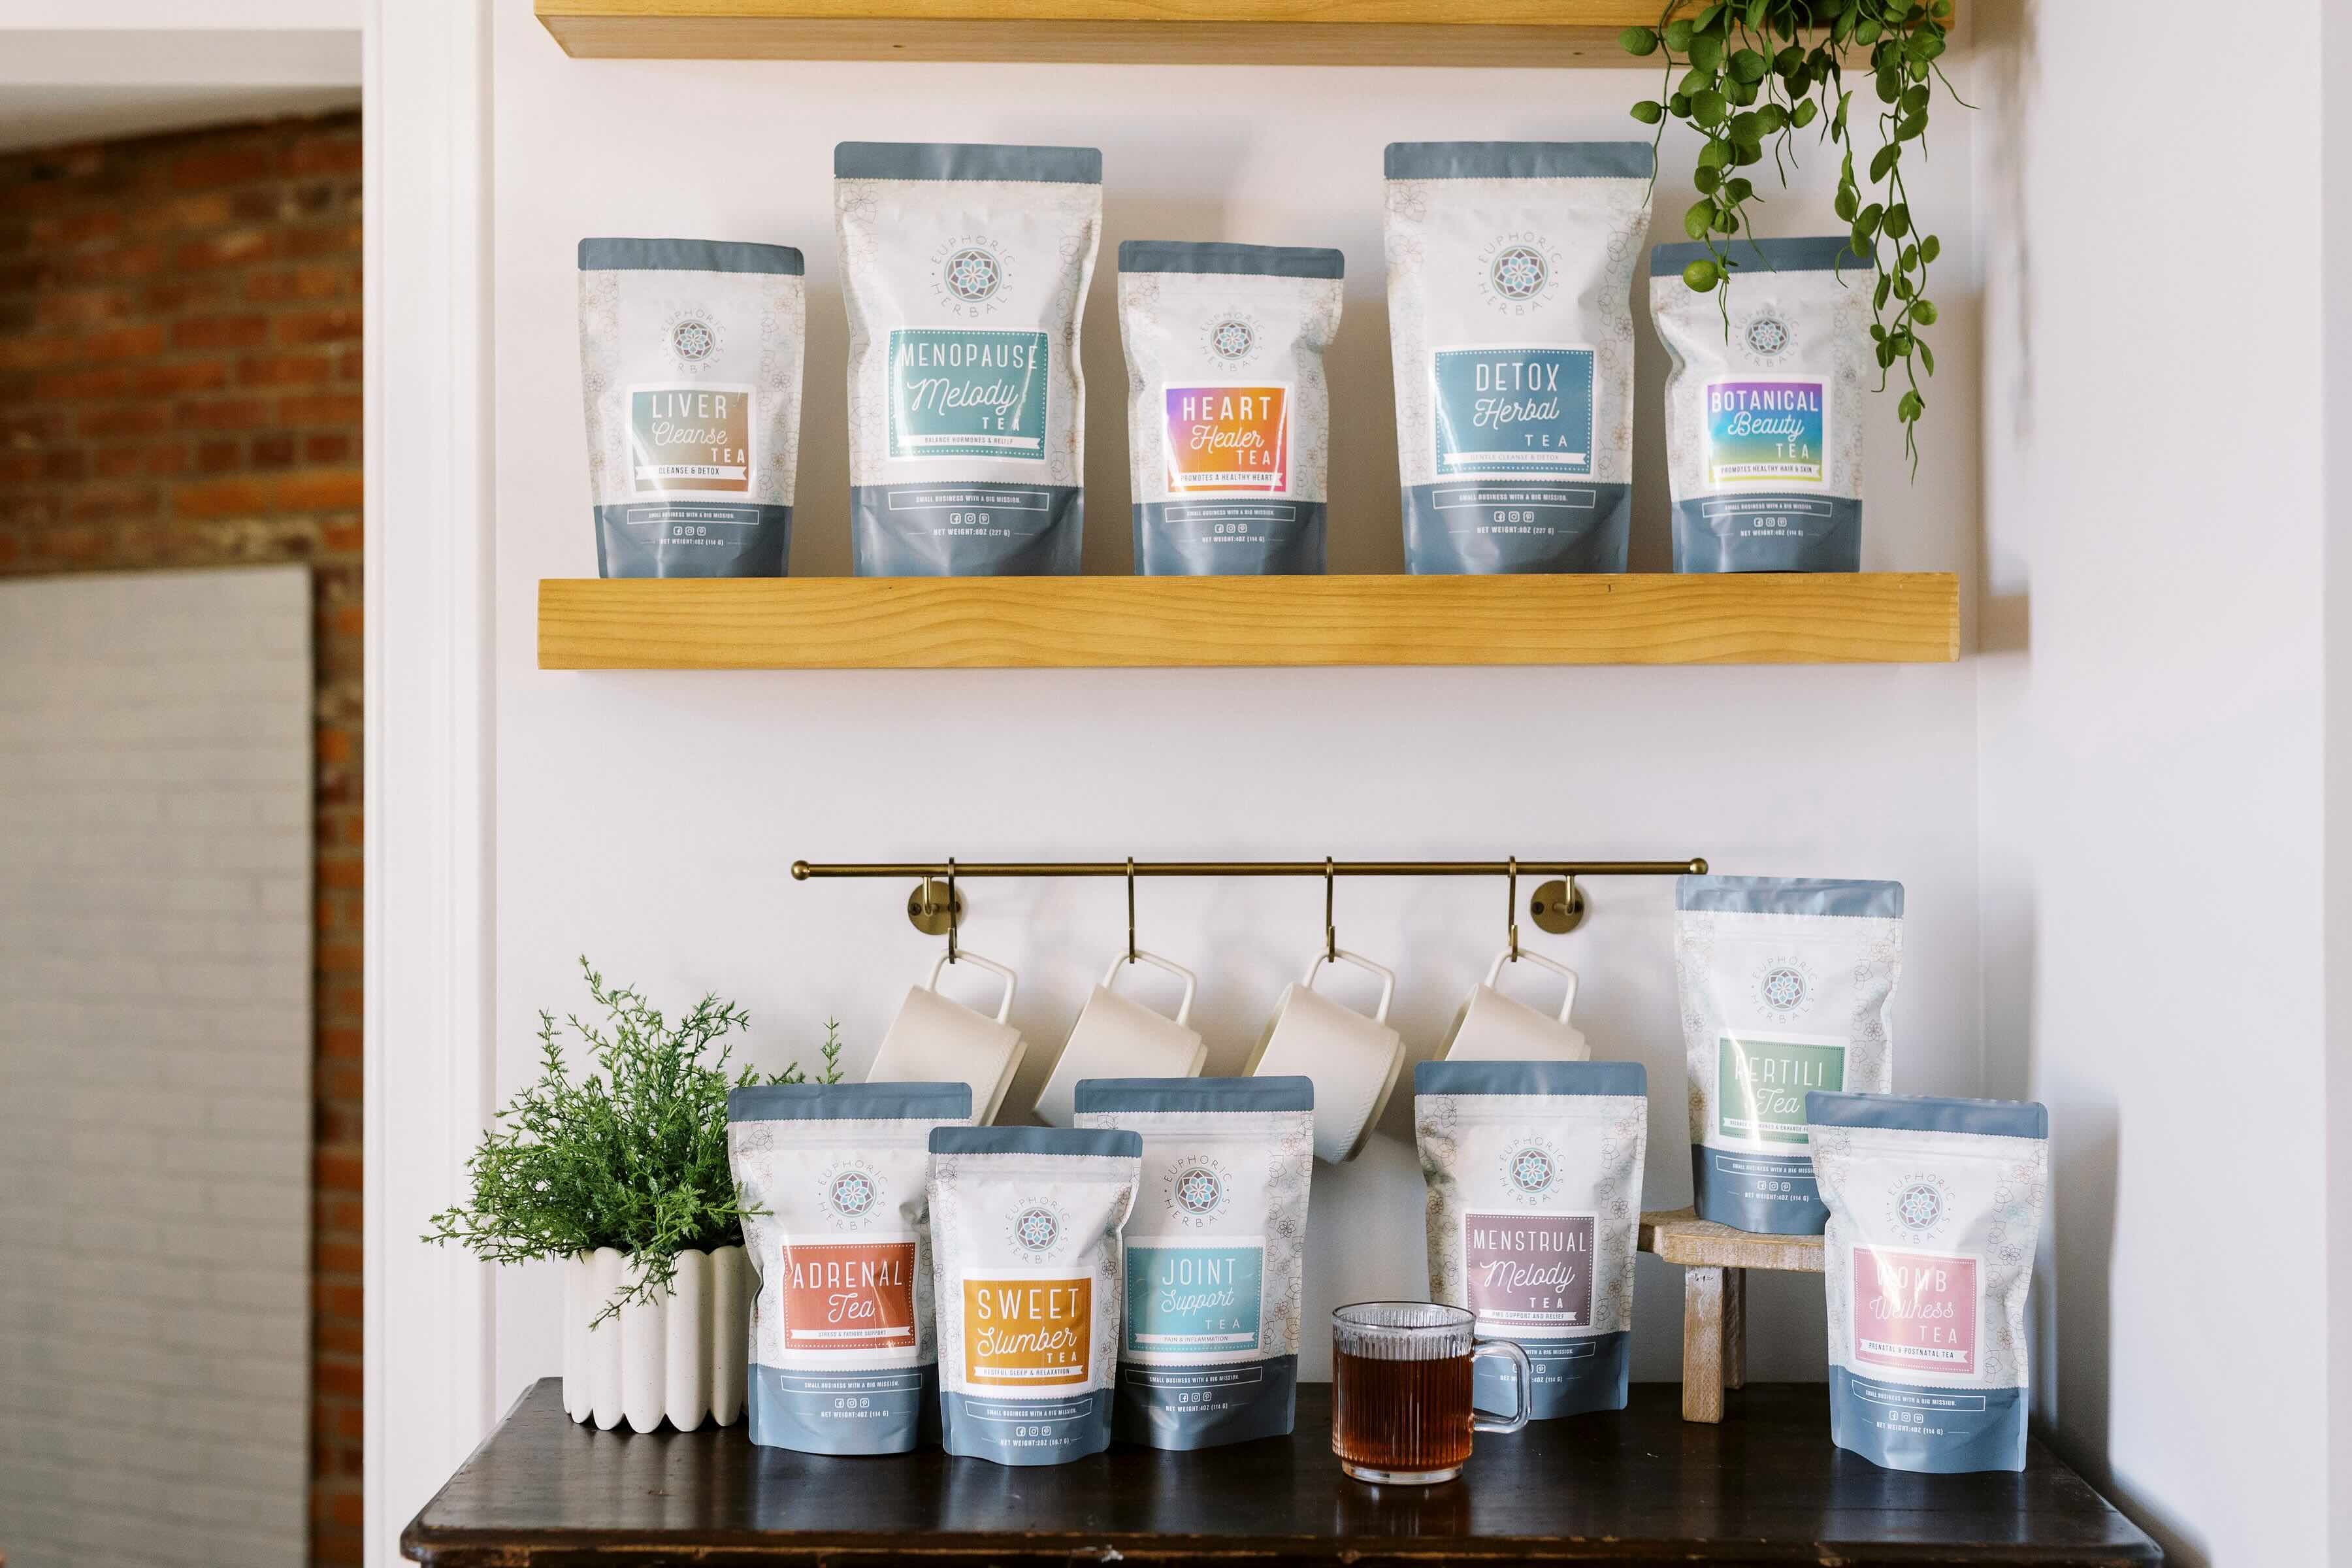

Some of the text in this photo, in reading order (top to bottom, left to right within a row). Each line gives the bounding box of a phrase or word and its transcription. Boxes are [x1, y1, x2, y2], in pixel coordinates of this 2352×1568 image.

[932, 235, 1016, 267] EUPHORIC
[1478, 231, 1563, 264] EUPHORIC
[901, 342, 1038, 369] MENOPAUSE
[1475, 362, 1560, 392] DETOX
[653, 393, 727, 419] LIVER
[906, 377, 1019, 416] Melody
[1183, 396, 1271, 421] HEART
[1711, 389, 1818, 413] BOTANICAL
[982, 417, 1021, 431] TEA
[1473, 397, 1560, 431] Herbal
[1727, 410, 1805, 443] Beauty
[652, 421, 728, 446] Cleanse
[1190, 423, 1265, 454] Healer
[1525, 434, 1568, 448] TEA
[711, 448, 745, 463] TEA
[1236, 449, 1271, 465] TEA
[1776, 442, 1809, 460] TEA
[698, 466, 720, 476] DETOX
[1755, 1087, 1800, 1116] Tea
[1499, 1136, 1566, 1161] EUPHORIC
[818, 1160, 888, 1185] EUPHORIC
[1164, 1154, 1232, 1183] EUPHORIC
[819, 1200, 885, 1231] HERBALS
[1165, 1198, 1230, 1228] HERBALS
[1473, 1228, 1586, 1253] MENSTRUAL
[792, 1260, 903, 1290] ADRENAL
[1162, 1258, 1237, 1286] JOINT
[1479, 1259, 1576, 1294] Melody
[827, 1292, 876, 1323] Tea
[977, 1288, 1079, 1320] SWEET
[1160, 1286, 1234, 1318] Support
[1529, 1297, 1563, 1309] TEA
[1869, 1295, 1955, 1320] Wellness
[1204, 1318, 1240, 1331] TEA
[1919, 1325, 1957, 1345] TEA
[977, 1326, 1078, 1358] Slumber
[1869, 1342, 1896, 1353] PRENATAL
[1904, 1348, 1939, 1358] POSTNATAL
[1047, 1352, 1077, 1364] TEA
